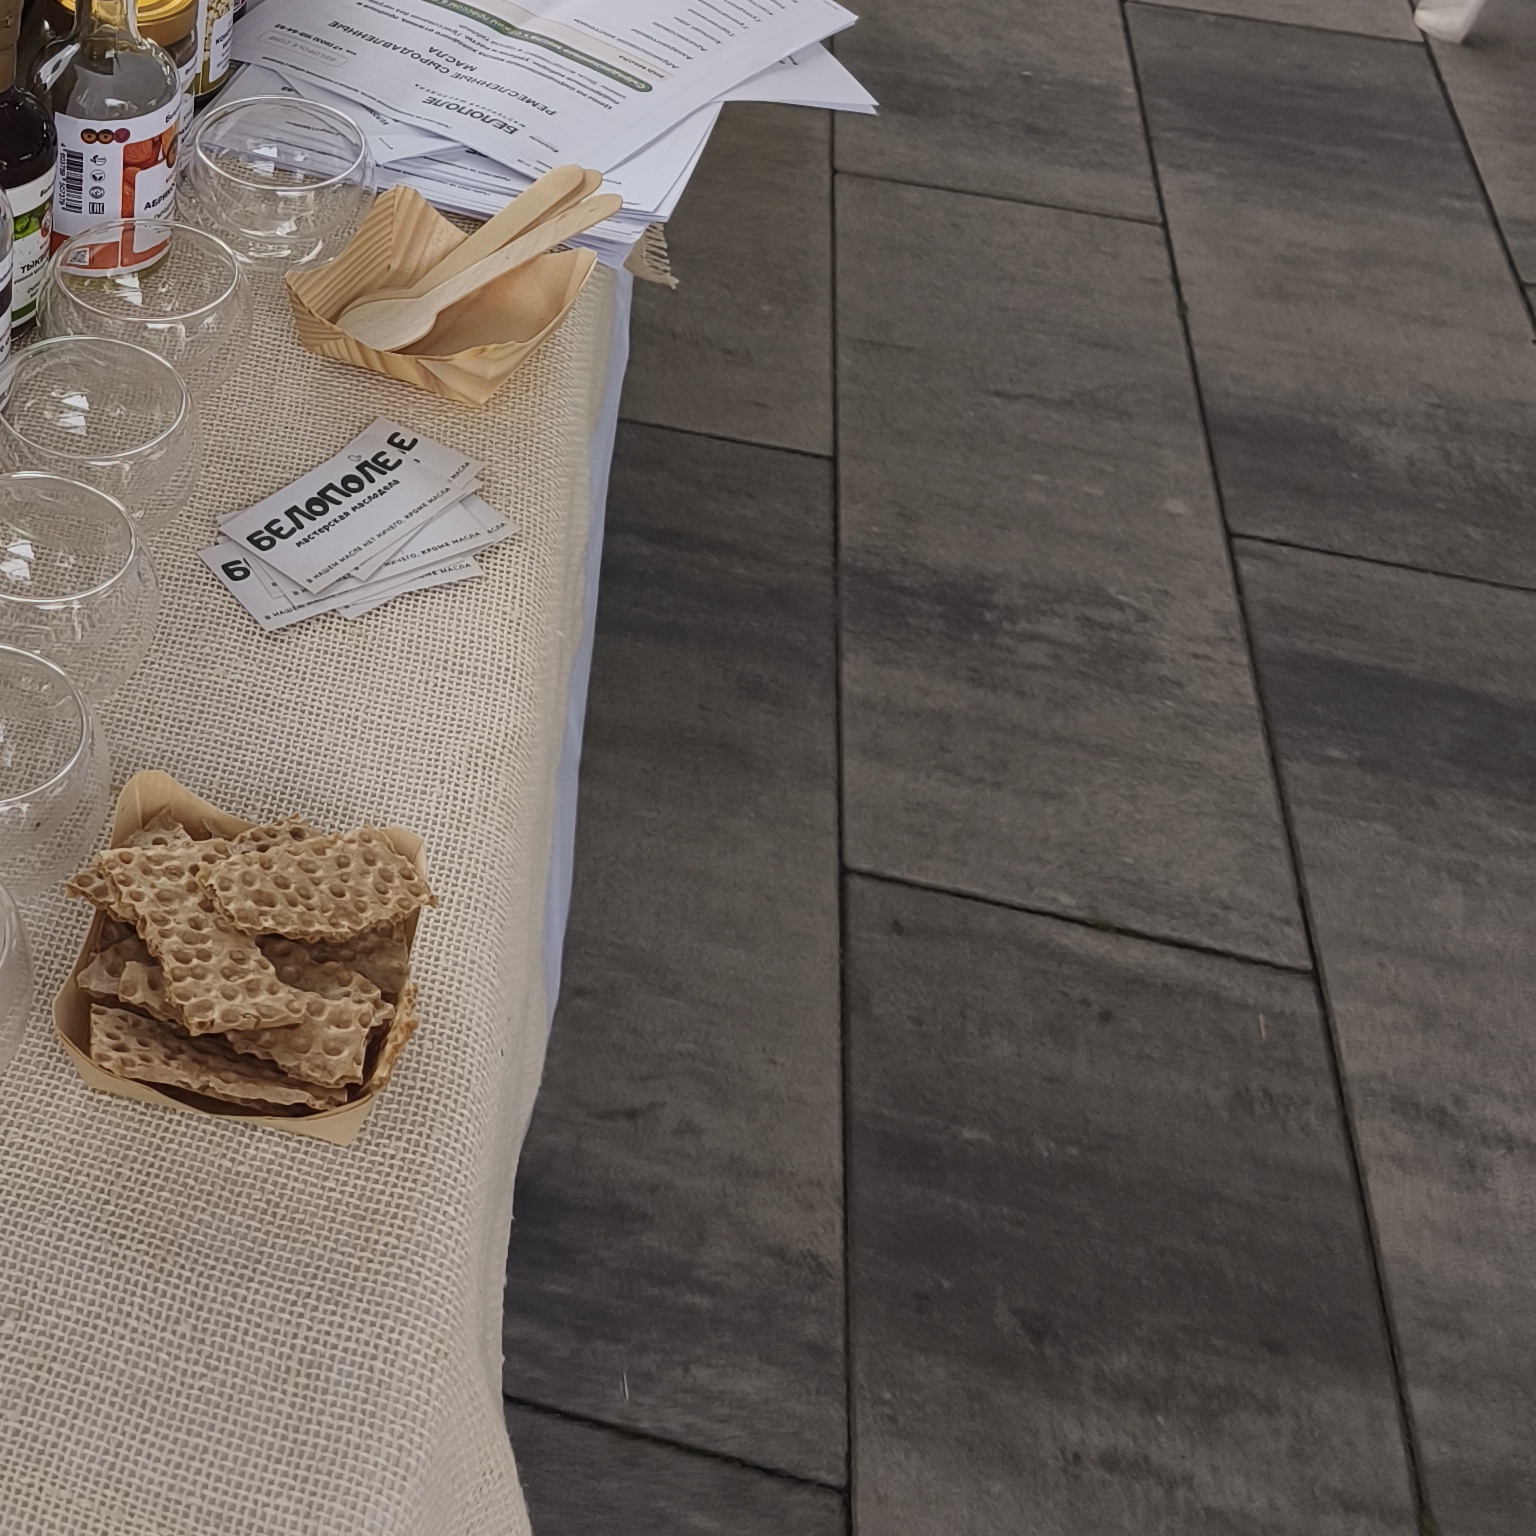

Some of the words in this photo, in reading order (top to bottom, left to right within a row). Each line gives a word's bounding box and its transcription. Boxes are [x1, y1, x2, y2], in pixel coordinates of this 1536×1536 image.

[328, 20, 449, 73] СЫРОДАВЛЕННЫЕ
[428, 46, 477, 71] МАСЛА
[423, 96, 518, 134] БЕЛОПОЛЕ
[451, 72, 556, 115] РЕМЕСЛЕННЫЕ
[246, 450, 404, 552] БЕЛОПОЛЕ
[295, 507, 351, 548] мастерская
[351, 479, 401, 513] маслодела
[313, 561, 339, 582] НАШЕМ
[338, 547, 364, 568] МАСЛЕ
[362, 538, 377, 554] НЕТ
[403, 501, 429, 523] КРОМЕ
[427, 486, 451, 505] МАСЛА
